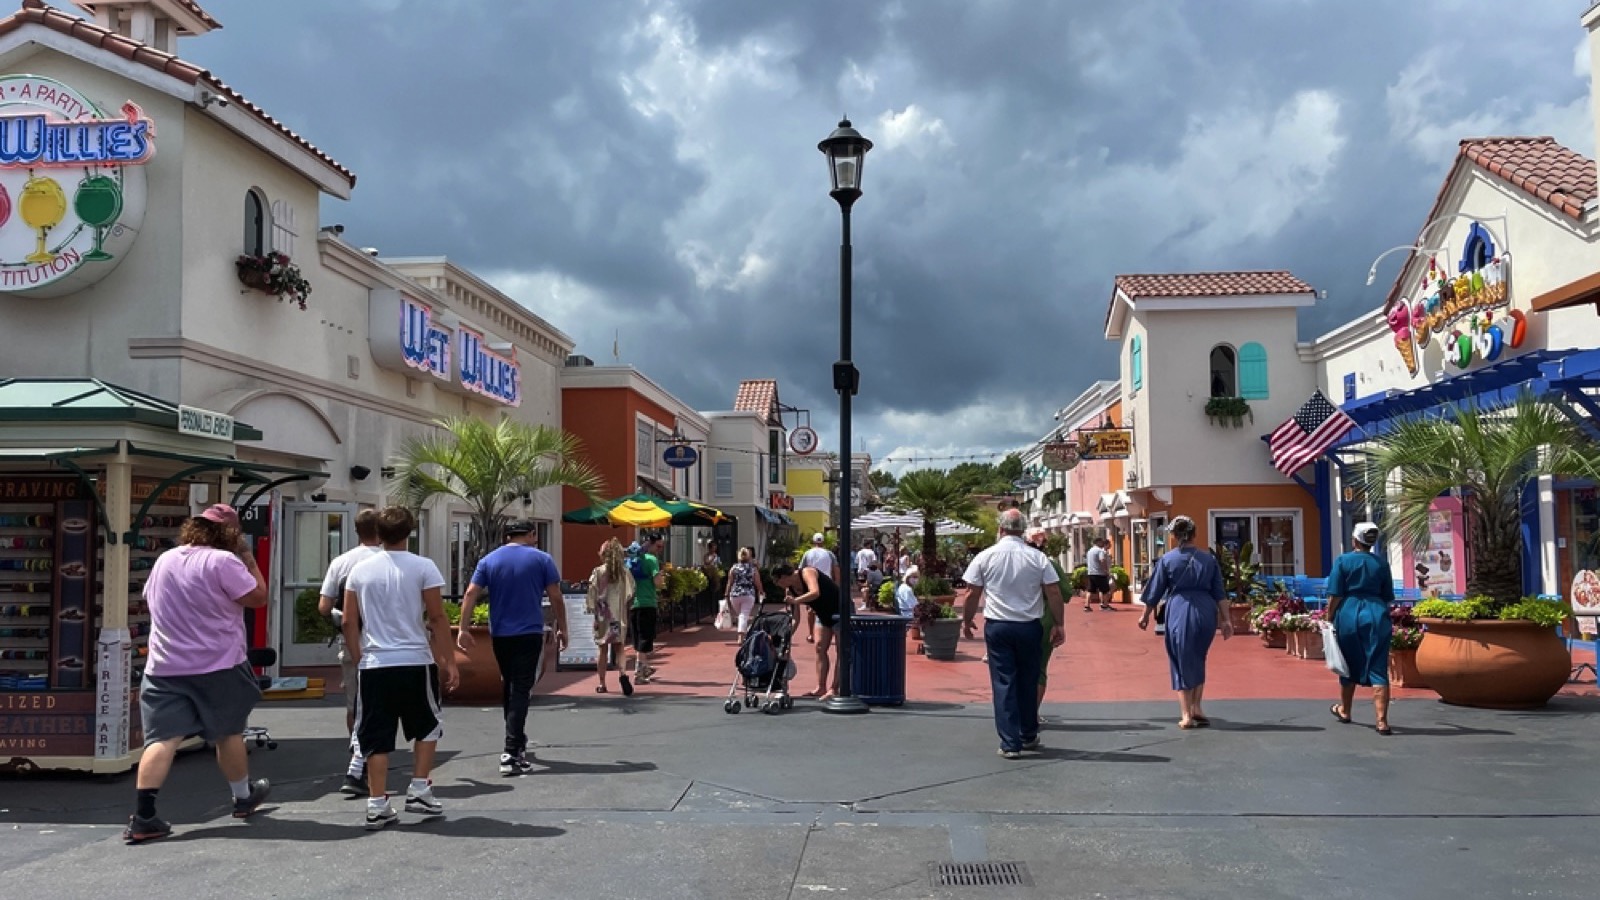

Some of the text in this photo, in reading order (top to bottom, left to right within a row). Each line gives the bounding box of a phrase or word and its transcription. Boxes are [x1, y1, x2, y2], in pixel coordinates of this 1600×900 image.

[20, 83, 31, 98] A
[36, 84, 89, 119] PARTY
[0, 482, 76, 498] RAVING
[99, 670, 110, 755] RICE ART
